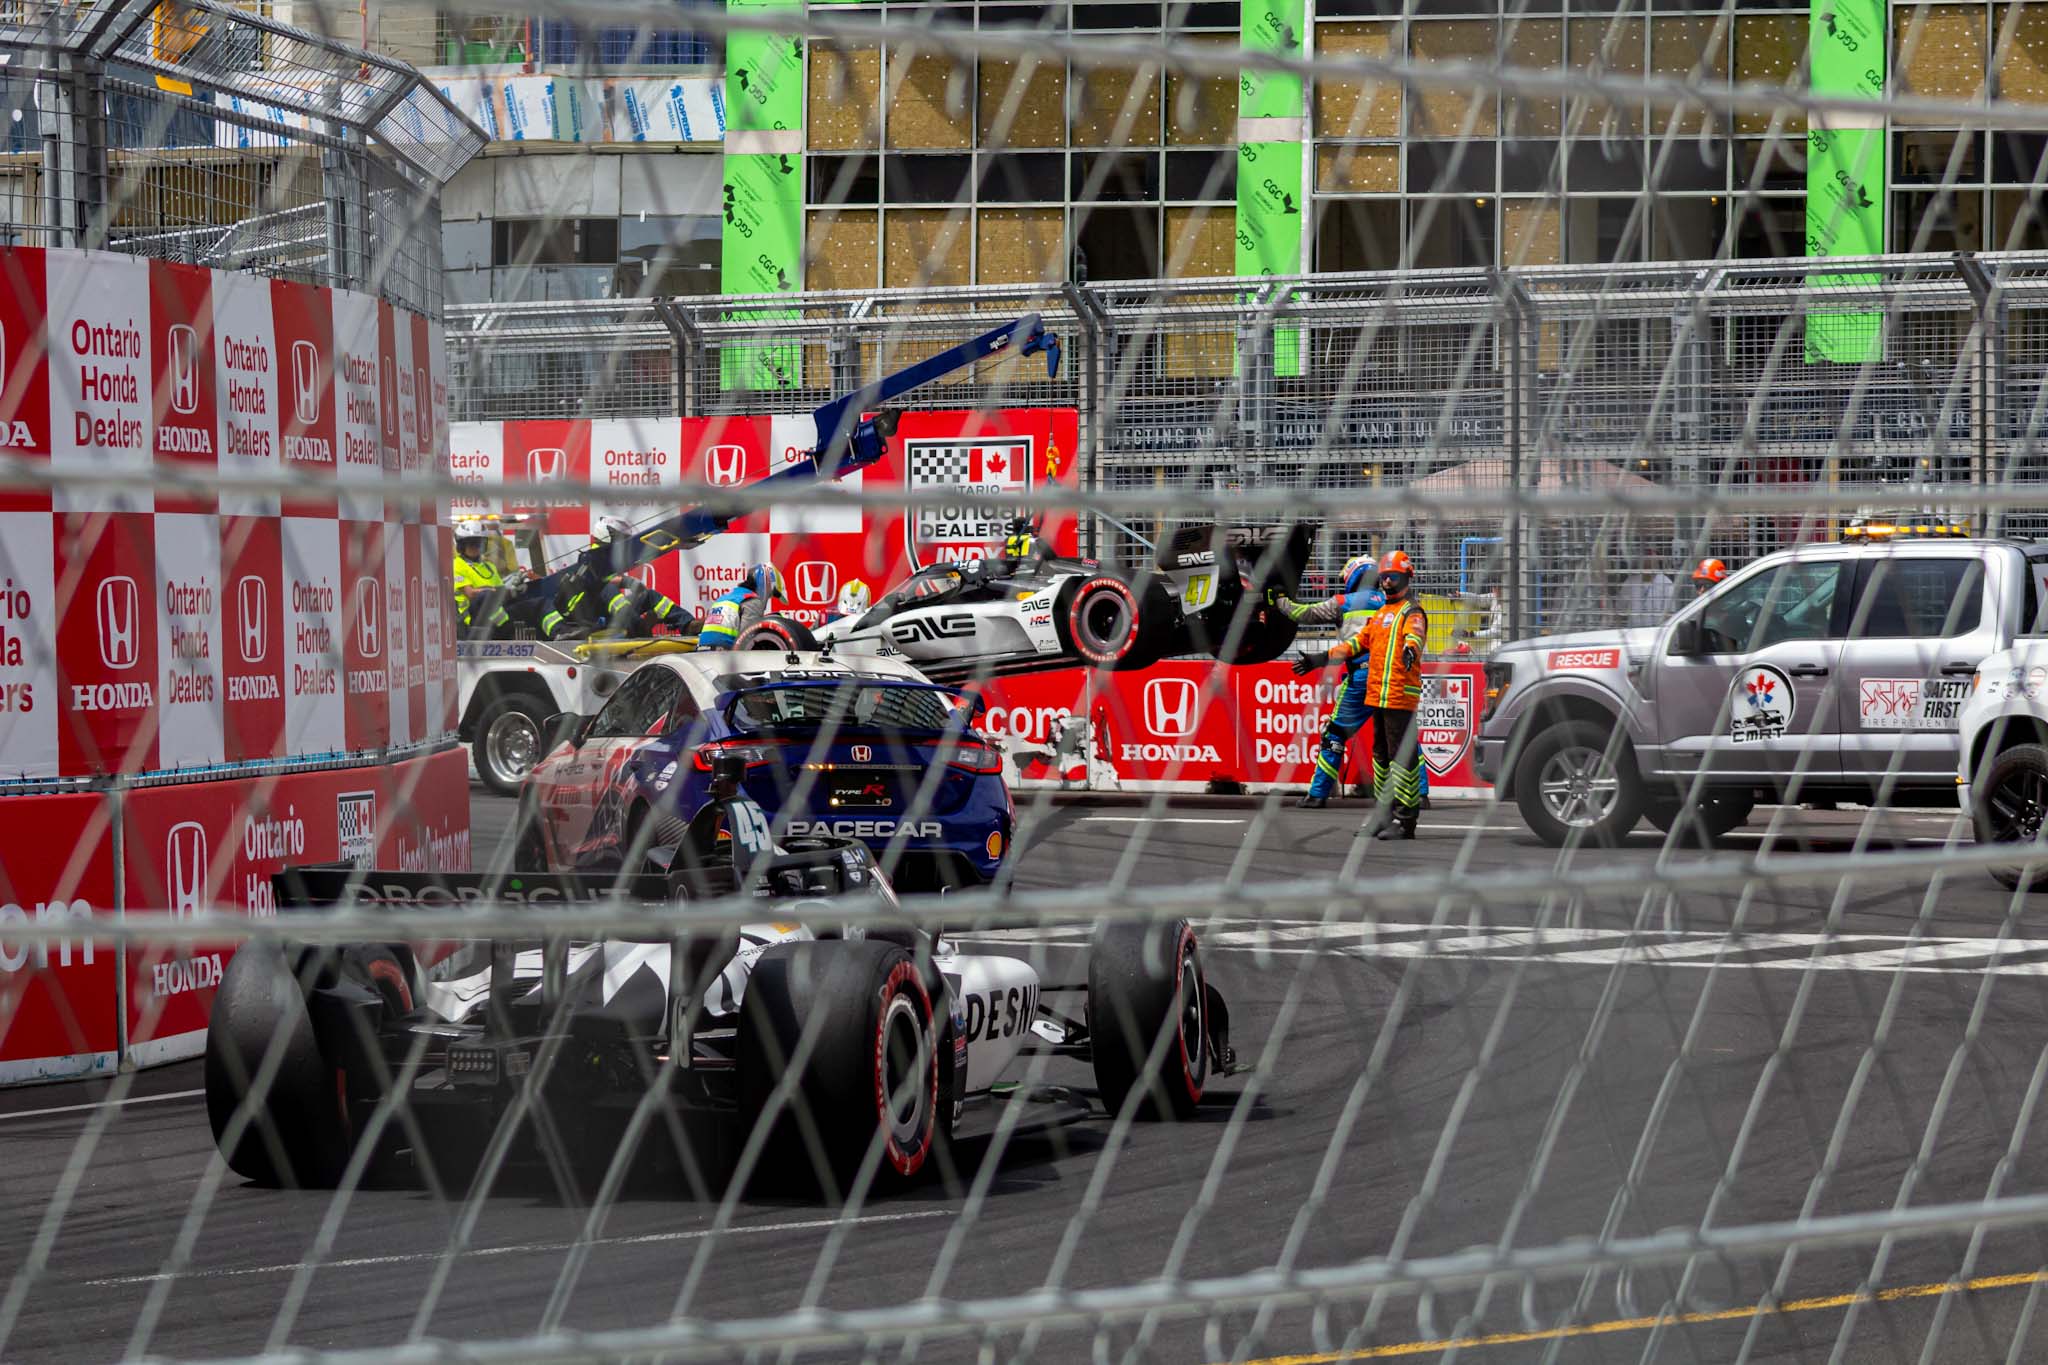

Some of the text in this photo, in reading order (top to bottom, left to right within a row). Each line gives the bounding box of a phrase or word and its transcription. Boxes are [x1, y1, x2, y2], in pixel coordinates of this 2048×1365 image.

[1837, 30, 1858, 52] CGC
[503, 84, 520, 131] SOPREMA
[624, 87, 641, 134] SOPREMA
[1263, 178, 1284, 200] CGC
[1835, 170, 1857, 192] CGC
[734, 218, 752, 238] CGC
[758, 254, 778, 275] CGC
[71, 318, 141, 360] Ontario
[224, 335, 268, 374] Ontario
[81, 363, 138, 404] Honda
[229, 377, 265, 415] Honda
[75, 408, 143, 450] Dealers
[158, 426, 213, 454] HONDA
[227, 420, 270, 457] Dealers
[1360, 422, 1392, 438] AND
[284, 435, 332, 463] HONDA
[451, 450, 490, 468] tario
[604, 448, 667, 467] Ontario
[608, 470, 661, 486] Honda
[953, 485, 1000, 495] TARIO
[920, 523, 1015, 537] DEALERS
[693, 562, 747, 581] Ontari
[167, 576, 212, 616] Ontario
[292, 576, 334, 614] Ontario
[699, 586, 730, 600] Hon
[1092, 579, 1127, 595] Firestone
[779, 609, 820, 622] HON
[171, 622, 209, 660] Honda
[296, 622, 331, 656] Honda
[482, 644, 535, 657] 222-4357
[1555, 652, 1613, 668] RESCUE
[169, 665, 214, 705] Dealers
[228, 673, 281, 701] HONDA
[293, 664, 336, 698] Dealers
[1923, 681, 1970, 698] SAFETY
[71, 682, 154, 711] HONDA
[1923, 701, 1961, 718] FIRST
[1861, 719, 1887, 727] FIRE
[1422, 731, 1457, 743] INDY
[1731, 726, 1785, 743] CMRT
[1121, 743, 1223, 763] HONDA
[1255, 737, 1340, 764] Deale
[863, 784, 885, 796] R
[244, 805, 304, 861] Ontario
[732, 800, 771, 853] 45
[787, 821, 942, 838] PACECAR
[246, 872, 279, 919] Hon
[153, 953, 223, 997] HONDA
